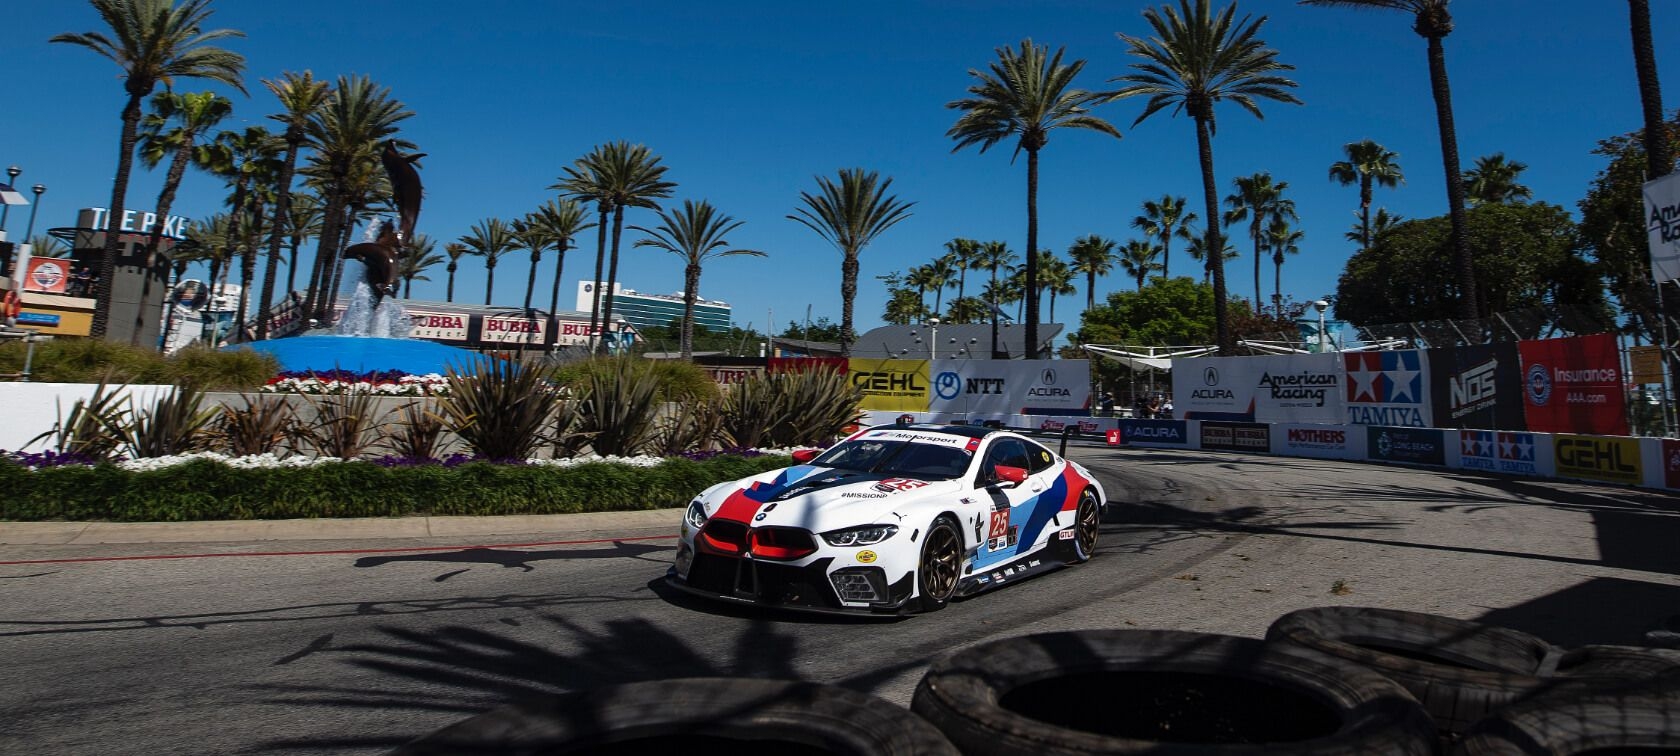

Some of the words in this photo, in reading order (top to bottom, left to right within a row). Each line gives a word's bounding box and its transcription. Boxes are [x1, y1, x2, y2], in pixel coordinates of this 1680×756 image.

[141, 212, 189, 240] PKE
[410, 315, 464, 329] UBBA
[487, 320, 542, 333] BUBBA
[562, 324, 605, 336] BUBB
[853, 371, 926, 391] GEHL
[1259, 371, 1337, 387] American
[1554, 367, 1617, 382] Insurance
[966, 378, 1005, 394] NTT
[1450, 359, 1498, 409] NOS
[1028, 387, 1071, 397] ACURA
[1191, 389, 1234, 399] ACURA
[1271, 384, 1328, 407] Racing
[1566, 392, 1606, 403] AAA.com
[1348, 406, 1426, 428] TAMIYA
[1133, 426, 1179, 438] ACURA
[1288, 428, 1345, 443] MOTHERS
[1557, 439, 1635, 472] GEHL
[992, 511, 1008, 536] 25
